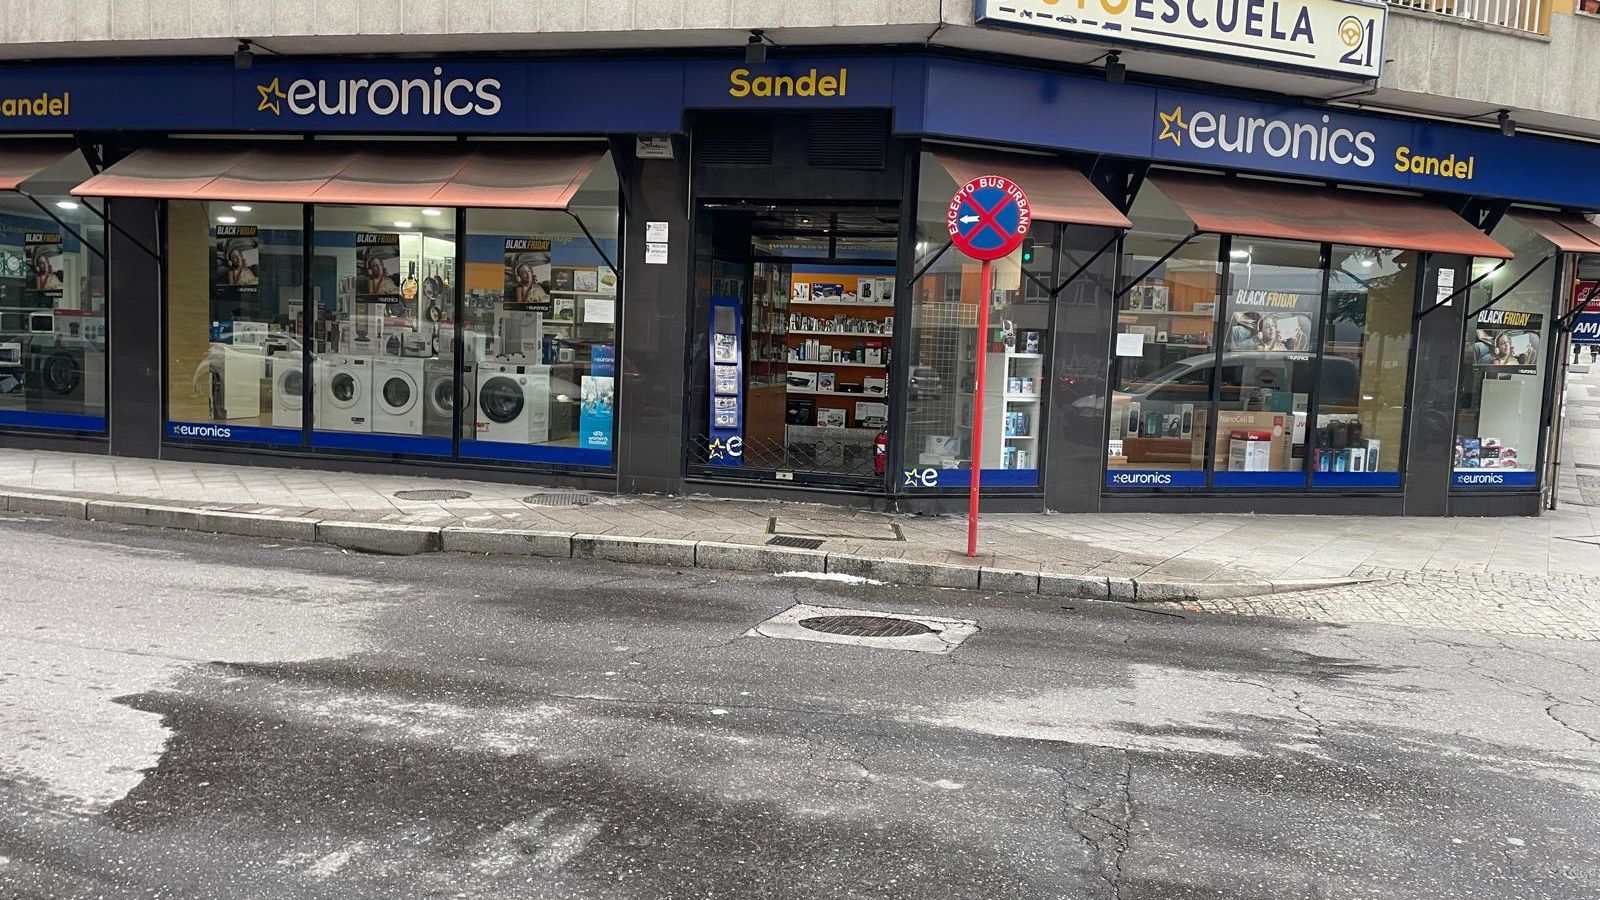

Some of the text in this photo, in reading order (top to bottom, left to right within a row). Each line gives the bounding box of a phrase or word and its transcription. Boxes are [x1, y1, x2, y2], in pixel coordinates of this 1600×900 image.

[1337, 15, 1375, 68] 21
[287, 66, 502, 116] euronics
[729, 68, 847, 97] Sandel
[0, 92, 69, 116] andel
[1188, 111, 1475, 180] euronics Sandel
[948, 178, 1029, 235] EXCEPTO BUS URBANO
[25, 233, 43, 242] BLACK
[217, 226, 236, 235] BLACK
[357, 230, 377, 243] BLACK
[505, 239, 550, 251] BLACK FRIDAY
[1236, 289, 1299, 308] BLACK FRIDAY
[1478, 309, 1530, 326] BLACK FRIDAY
[180, 424, 231, 438] euronics
[1120, 471, 1172, 484] euronics
[1463, 473, 1504, 484] euronics
